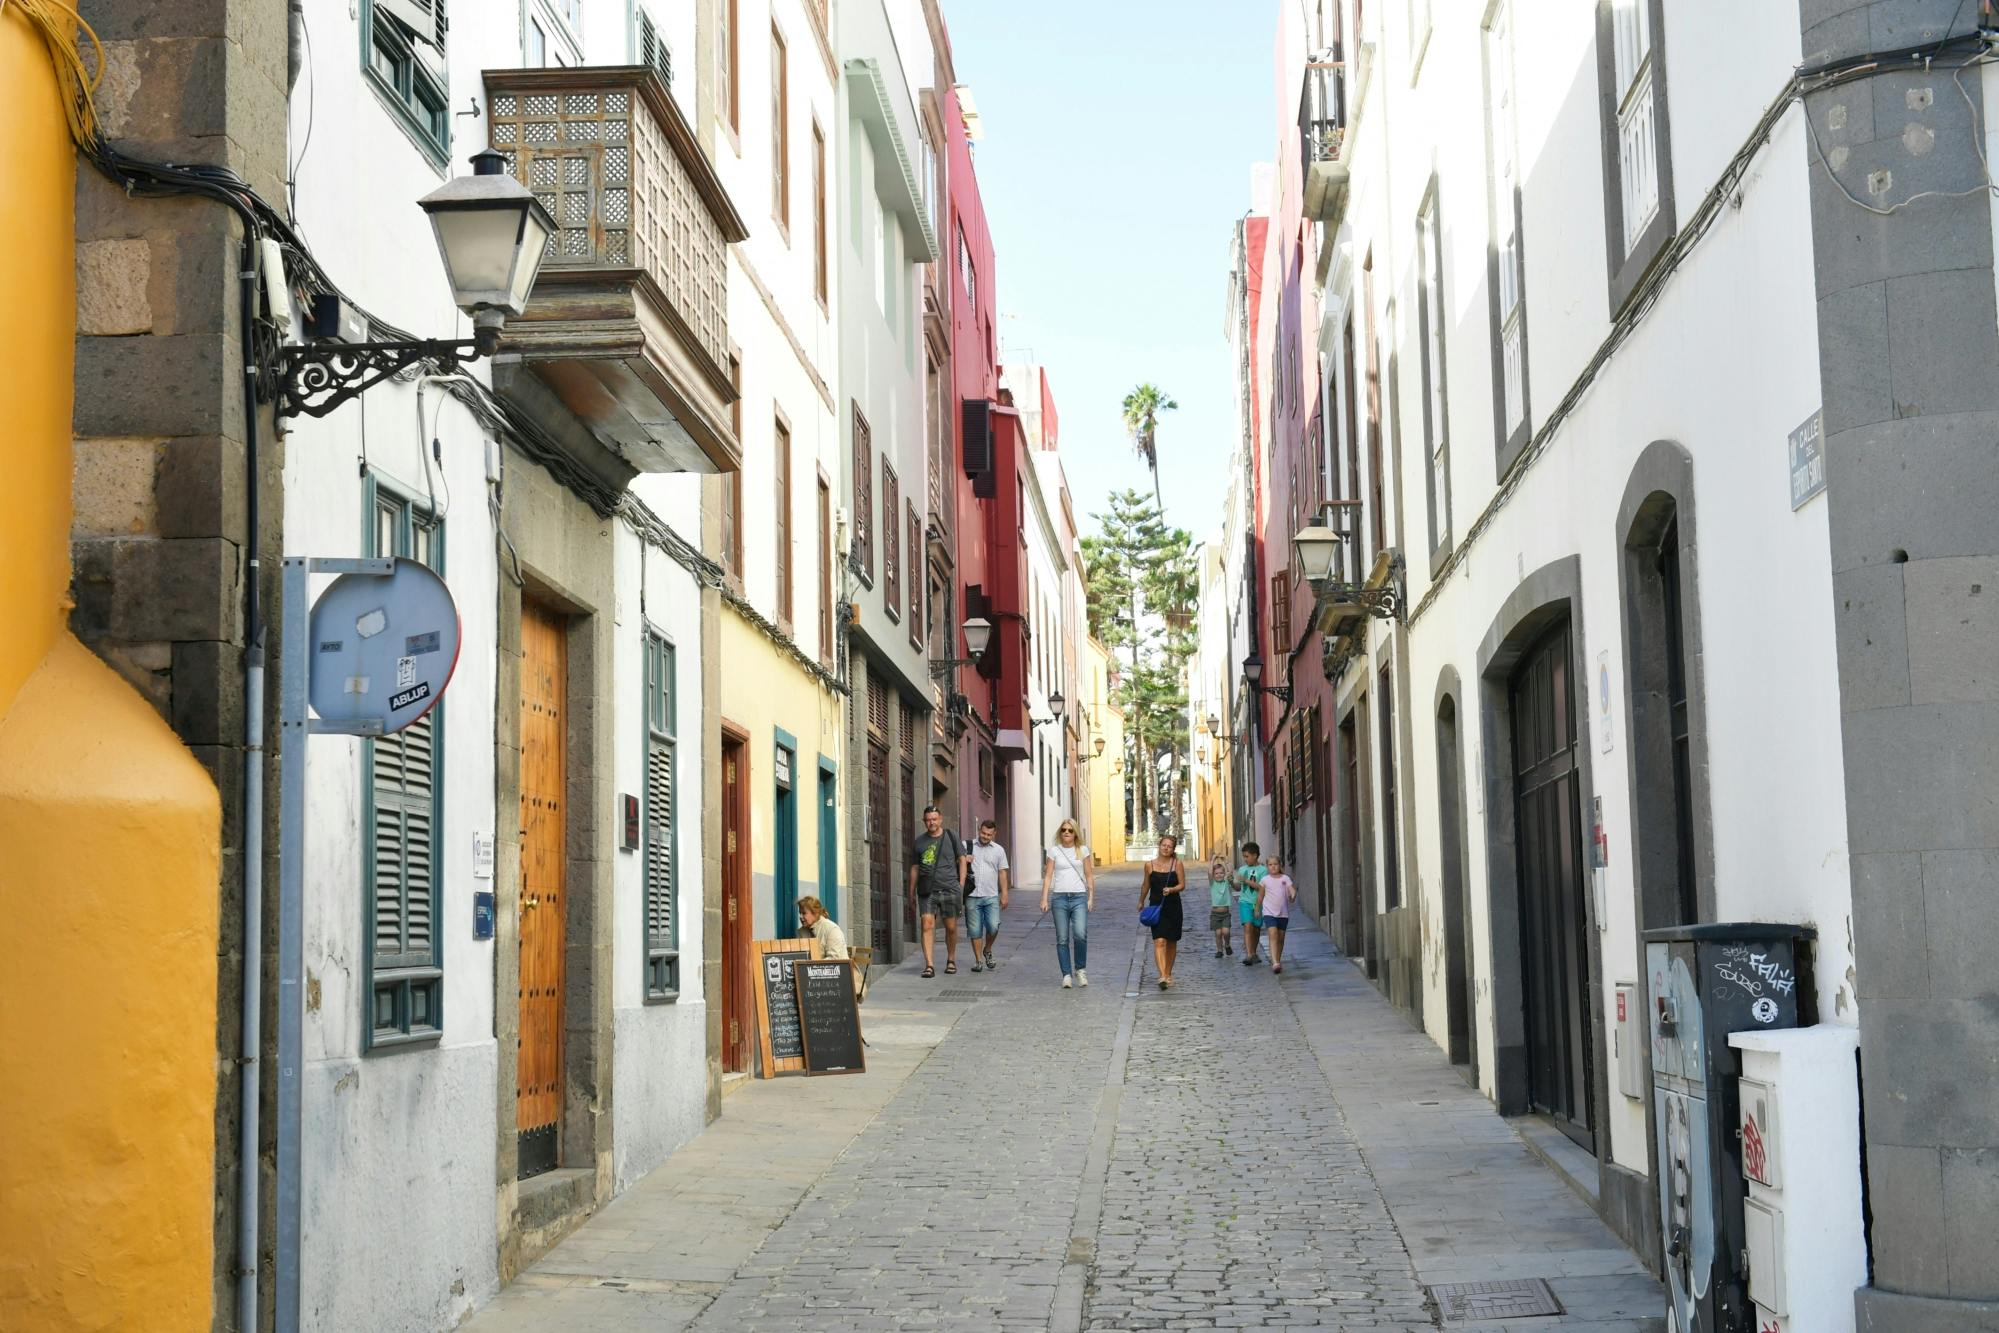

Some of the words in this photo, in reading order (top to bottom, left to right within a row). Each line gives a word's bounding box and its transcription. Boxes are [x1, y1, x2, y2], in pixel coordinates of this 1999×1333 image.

[1799, 418, 1819, 449] CALLE
[1806, 445, 1815, 457] DEL
[392, 685, 428, 709] ABLUP
